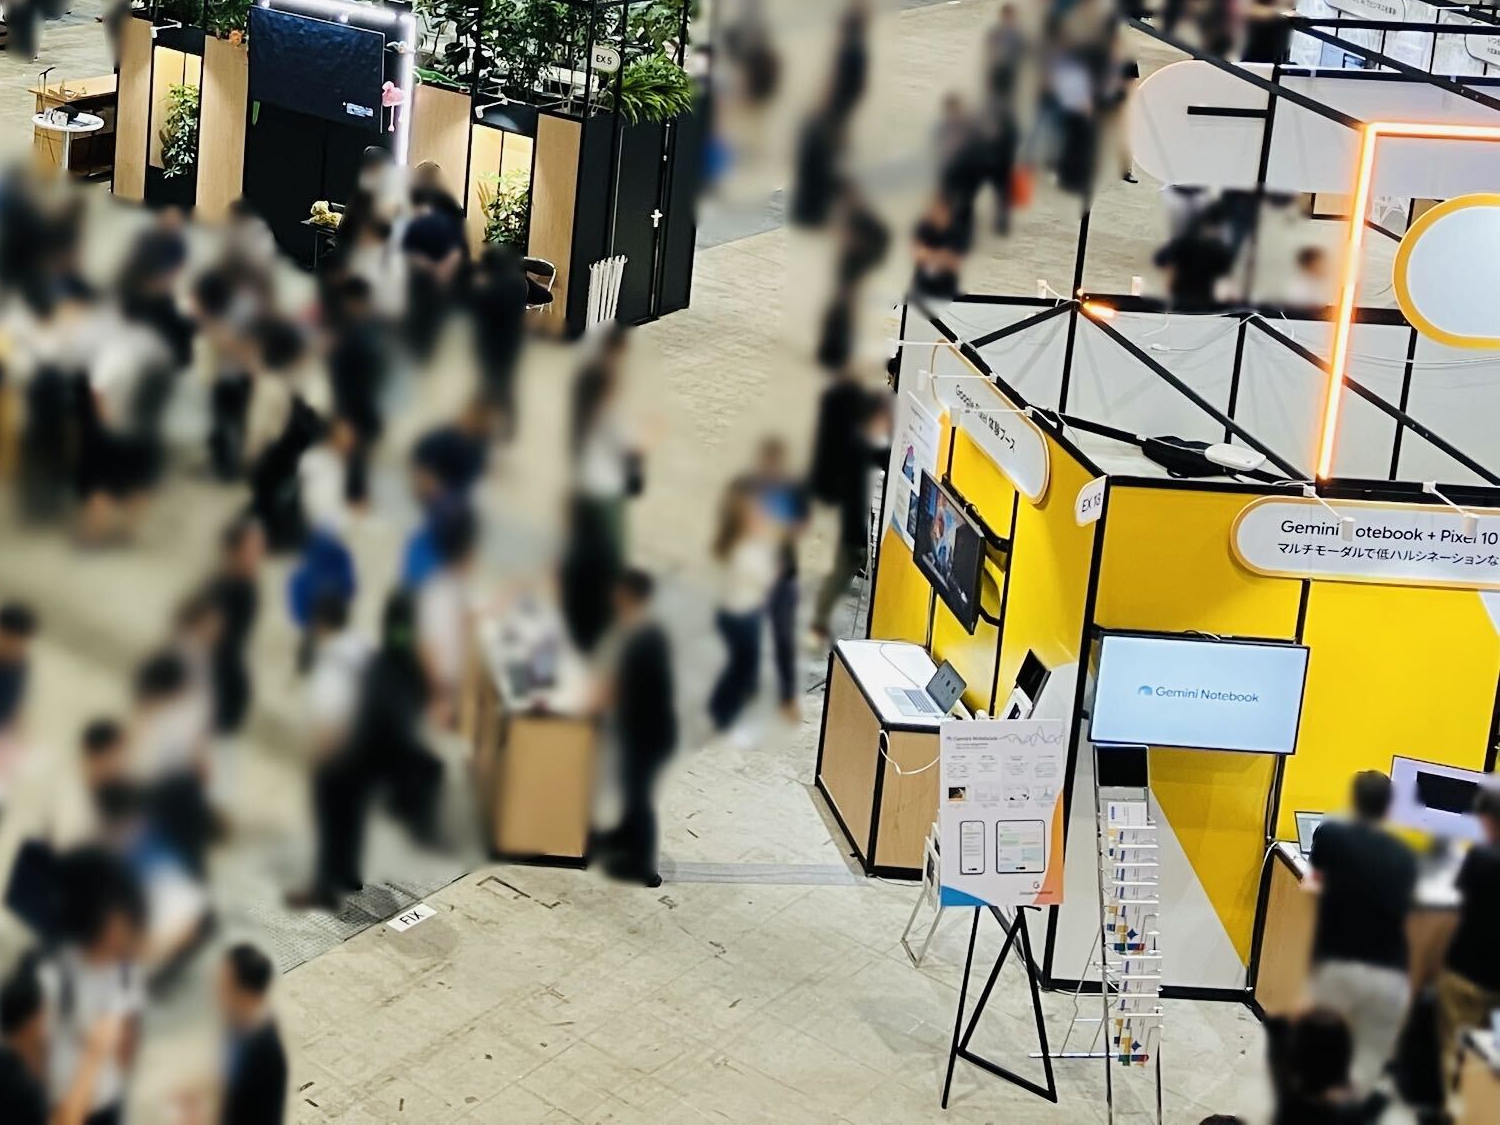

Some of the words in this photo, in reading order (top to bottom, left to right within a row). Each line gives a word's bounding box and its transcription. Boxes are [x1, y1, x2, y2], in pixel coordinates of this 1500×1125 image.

[596, 54, 606, 63] EX
[607, 57, 612, 65] 5
[1081, 498, 1093, 513] EX
[1281, 519, 1340, 537] Gemini
[1355, 527, 1423, 542] otebook
[1440, 529, 1478, 545] Pixe
[1482, 531, 1498, 545] 10
[1277, 542, 1500, 567] マルチモーダルで低ハルシネーションな
[1155, 686, 1199, 700] Gemini
[1200, 689, 1260, 703] Notebook
[399, 910, 425, 925] FIX
